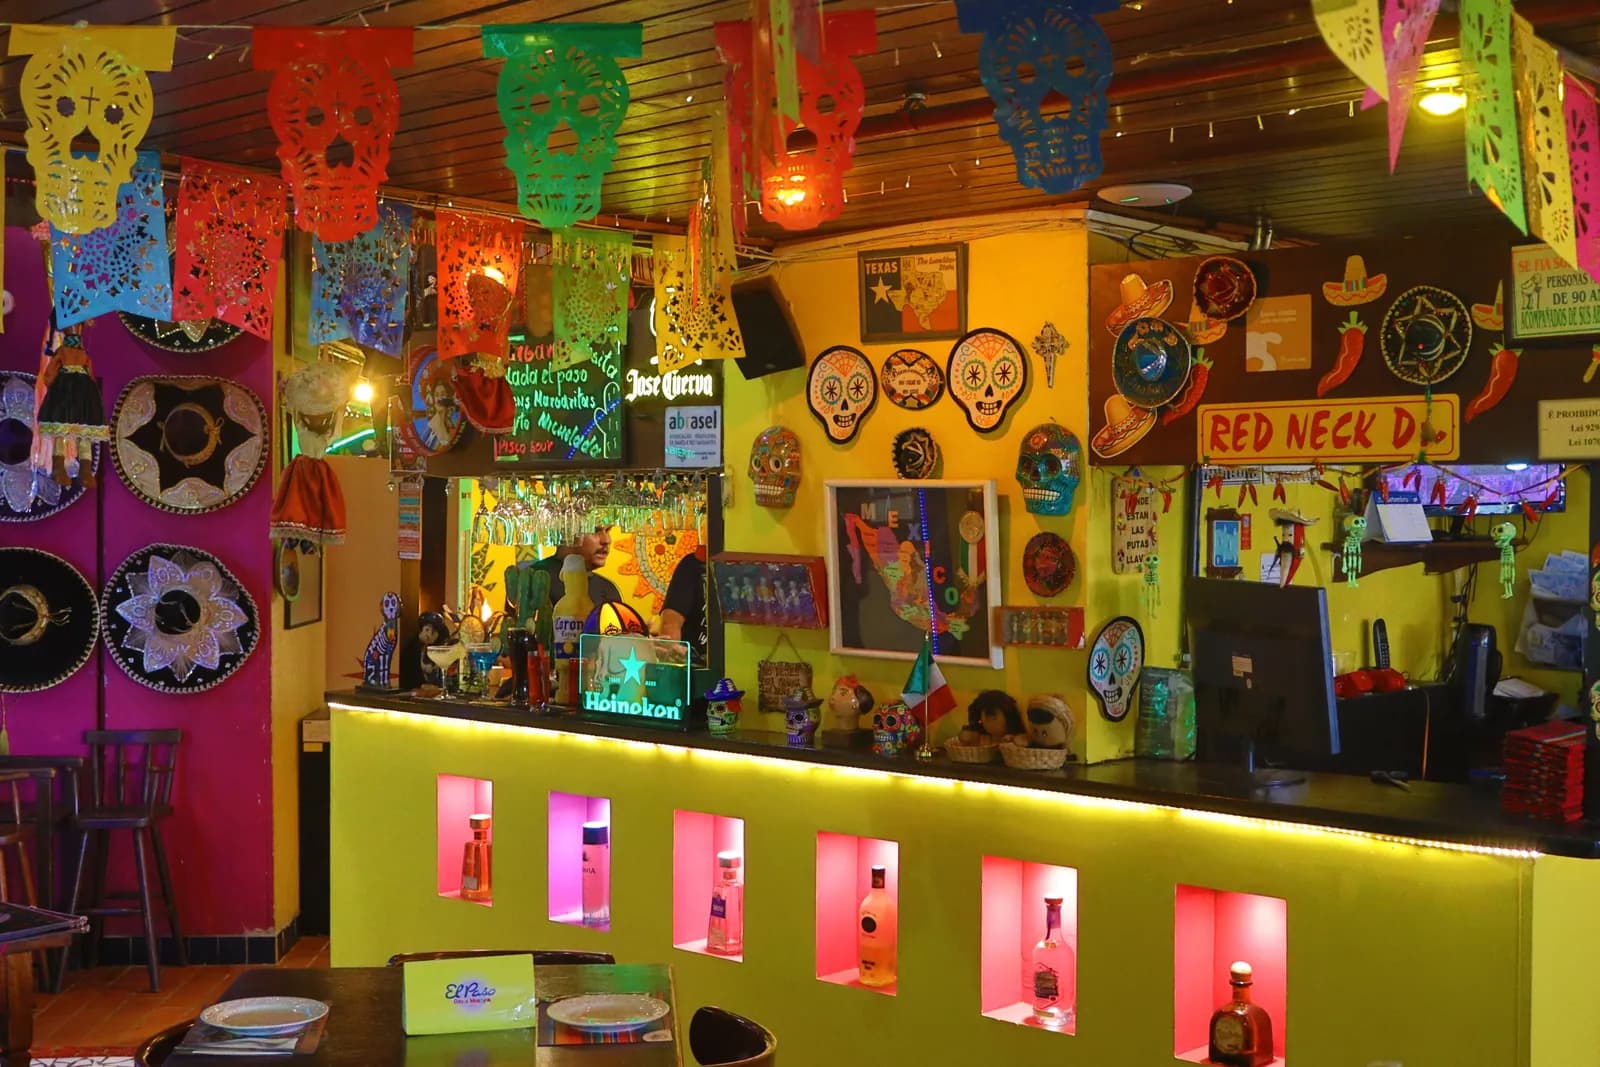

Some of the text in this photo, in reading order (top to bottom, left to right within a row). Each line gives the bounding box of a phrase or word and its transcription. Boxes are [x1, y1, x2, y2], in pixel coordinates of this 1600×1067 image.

[865, 261, 898, 275] TEXAS
[1546, 273, 1589, 288] PERSONAS
[1553, 292, 1568, 305] DE
[1572, 290, 1586, 303] 90
[541, 362, 554, 384] el
[557, 368, 588, 396] paso
[625, 368, 713, 402] Jose Cuervo
[669, 409, 717, 430] abrasel
[1210, 412, 1273, 453] RED
[1286, 409, 1376, 450] NECK
[1127, 512, 1148, 521] ESTAN
[1132, 527, 1144, 535] LAS
[1127, 540, 1149, 550] PUTAS
[1126, 554, 1144, 564] LLAV
[555, 616, 584, 631] Coron
[445, 982, 496, 999] El Paso
